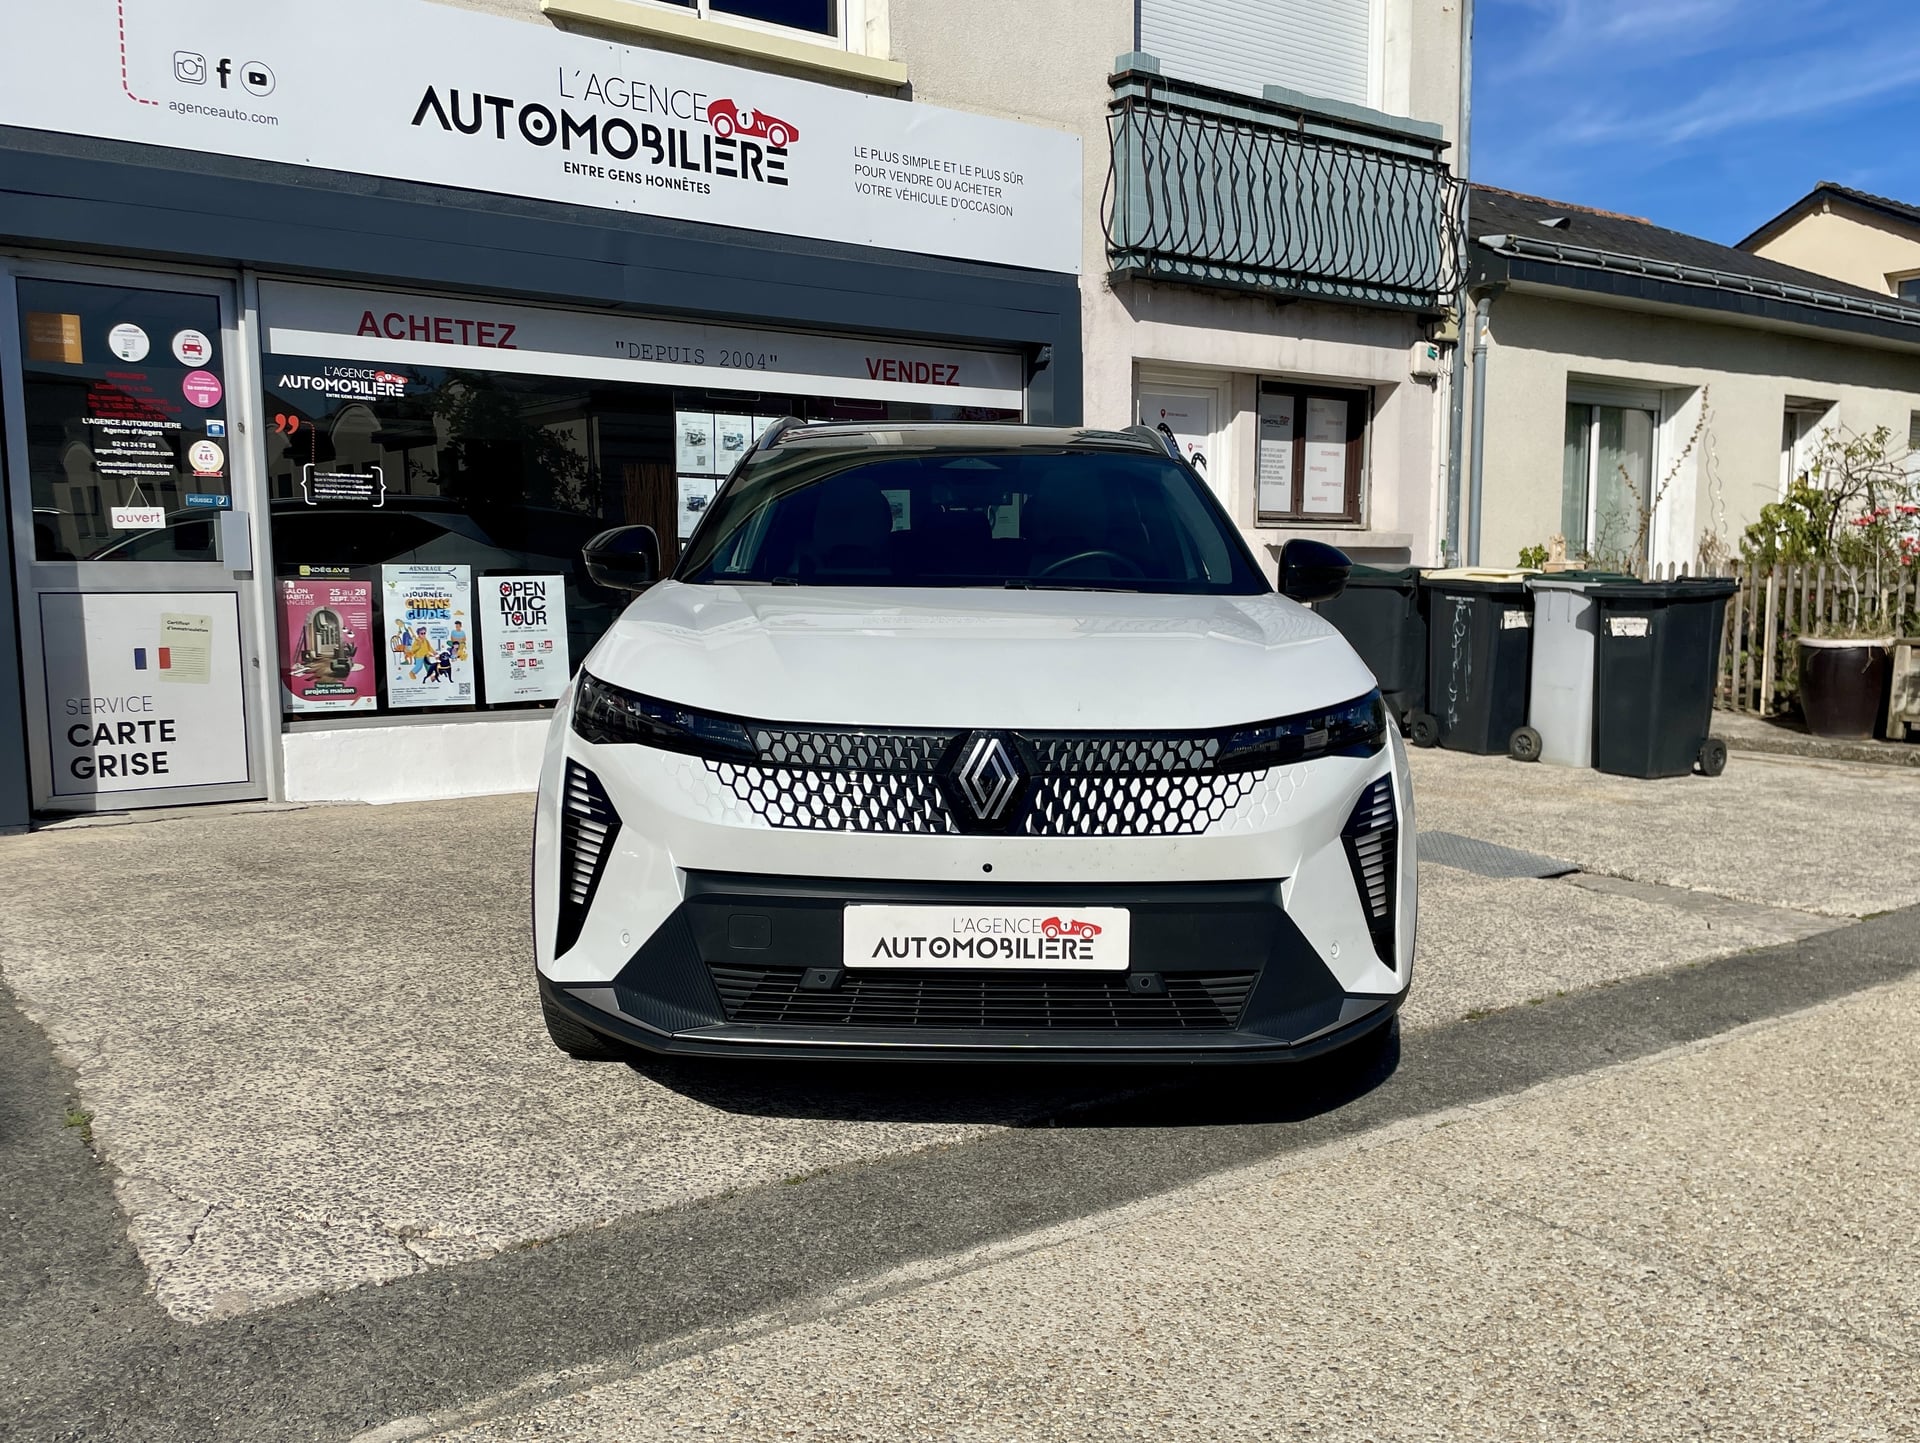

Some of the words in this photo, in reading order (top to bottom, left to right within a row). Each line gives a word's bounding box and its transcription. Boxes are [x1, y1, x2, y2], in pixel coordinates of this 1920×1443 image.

[559, 67, 708, 123] L'AGENCE
[169, 101, 279, 126] agenceauto.com
[740, 112, 748, 125] 1
[854, 146, 868, 158] LE
[871, 149, 899, 164] PLUS
[902, 154, 940, 171] SIMPLE
[944, 162, 956, 173] ET
[959, 164, 972, 176] LE
[974, 167, 1000, 181] PLUS
[1003, 171, 1024, 185] SÛR
[564, 162, 604, 179] ENTRE
[608, 170, 642, 184] GENS
[646, 176, 710, 194] HONNÊTES
[854, 164, 886, 180] POUR
[889, 170, 933, 187] VENDRE
[936, 178, 952, 190] OU
[954, 181, 1002, 198] ACHETER
[854, 182, 892, 198] VOTRE
[895, 187, 948, 206] VÉHICULE
[952, 198, 1013, 216] D'OCCASION
[356, 310, 517, 349] ACHETEZ
[324, 366, 375, 380] L'AGENCE
[865, 357, 960, 386] VENDEZ
[122, 420, 182, 429] AUTOMOBILIERE
[132, 428, 163, 436] d'Angers
[116, 512, 160, 523] ouvert
[500, 581, 545, 597] OPEN
[405, 598, 451, 609] CHIENS
[500, 596, 546, 611] MIC
[406, 609, 451, 620] GUIDES
[501, 611, 547, 626] TOUR
[66, 696, 153, 716] SERVICE
[67, 719, 176, 747] CARTE
[70, 751, 169, 779] GRISE
[952, 918, 1042, 934] L'AGENCE
